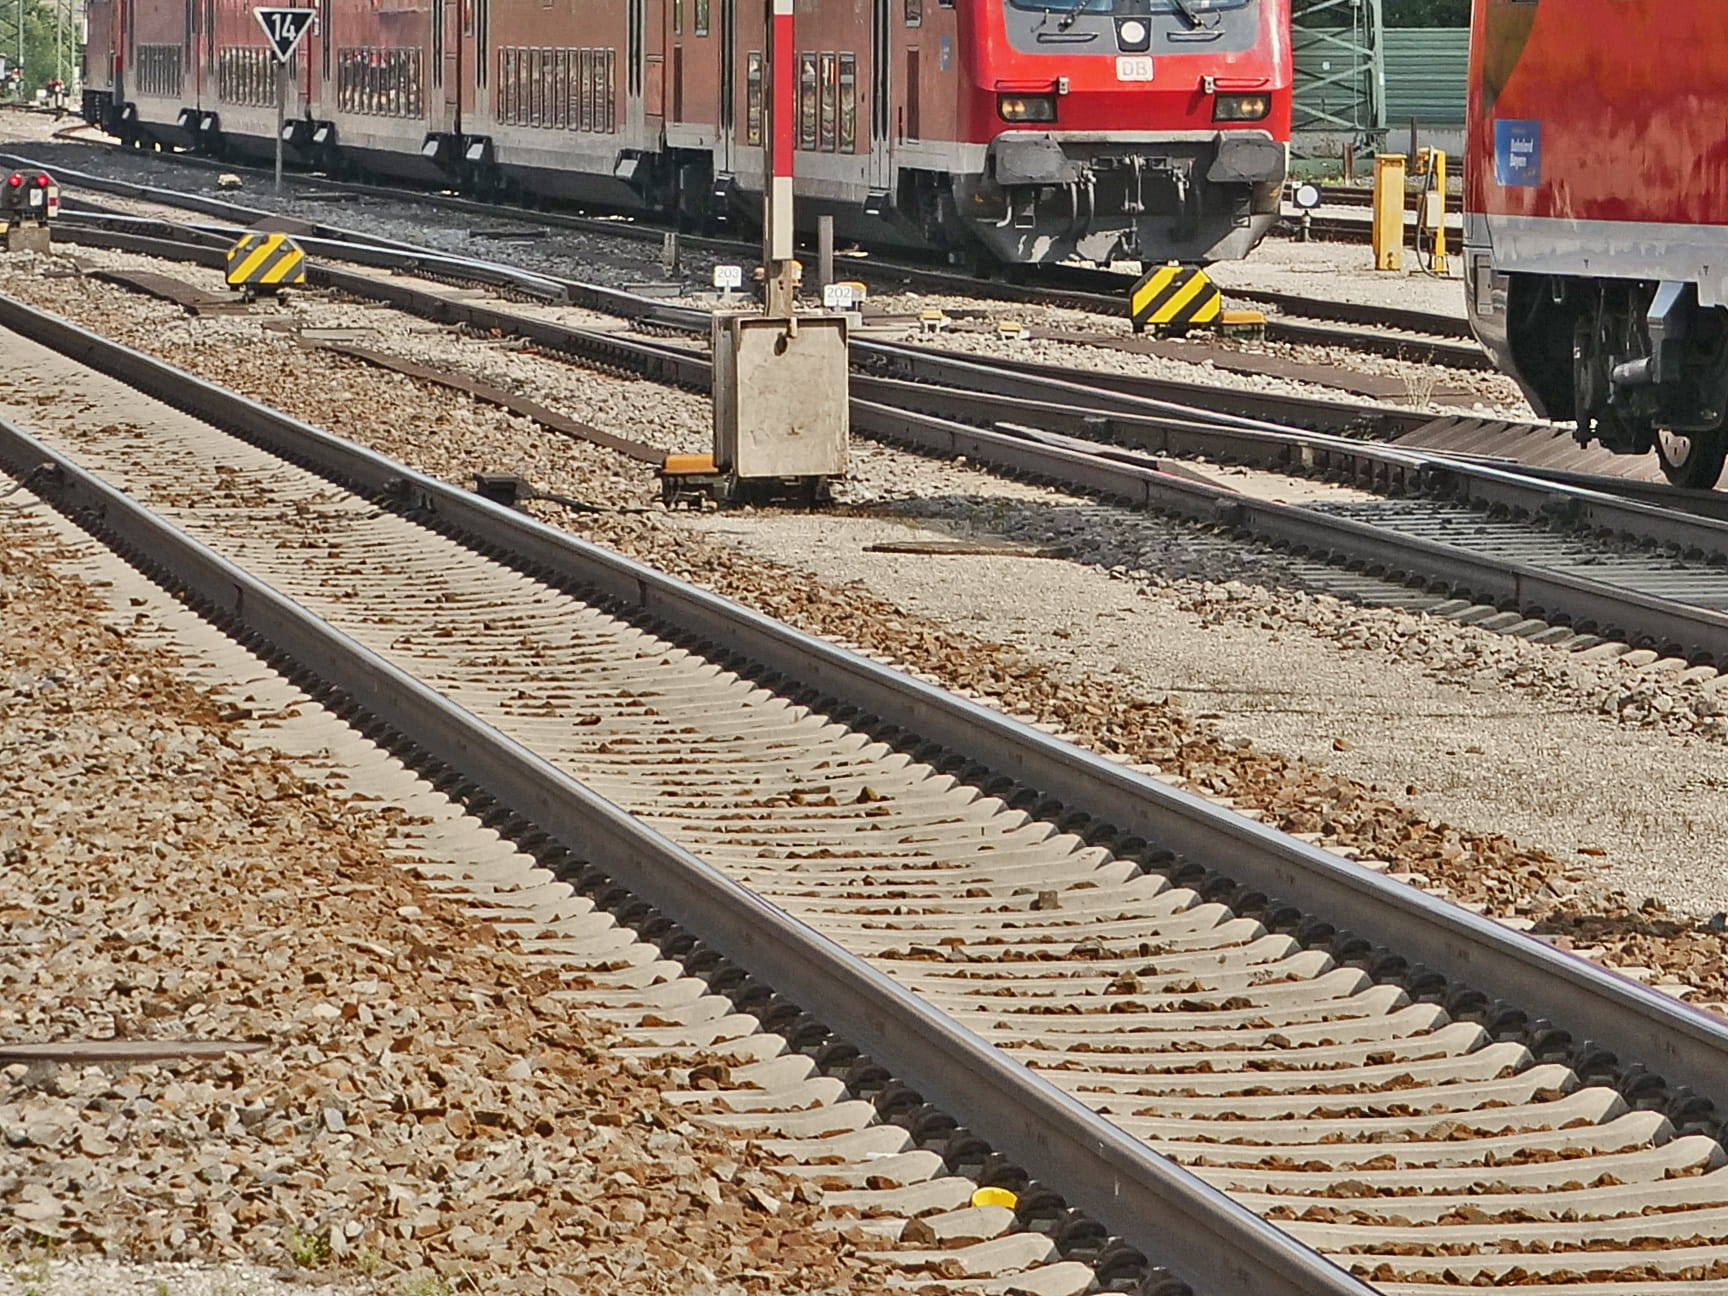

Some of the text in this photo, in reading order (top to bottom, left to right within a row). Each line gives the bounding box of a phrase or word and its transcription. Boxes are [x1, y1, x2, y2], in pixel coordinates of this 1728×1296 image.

[271, 13, 297, 41] 14
[1120, 59, 1150, 78] DB
[717, 268, 739, 279] 203
[827, 286, 851, 299] 202
